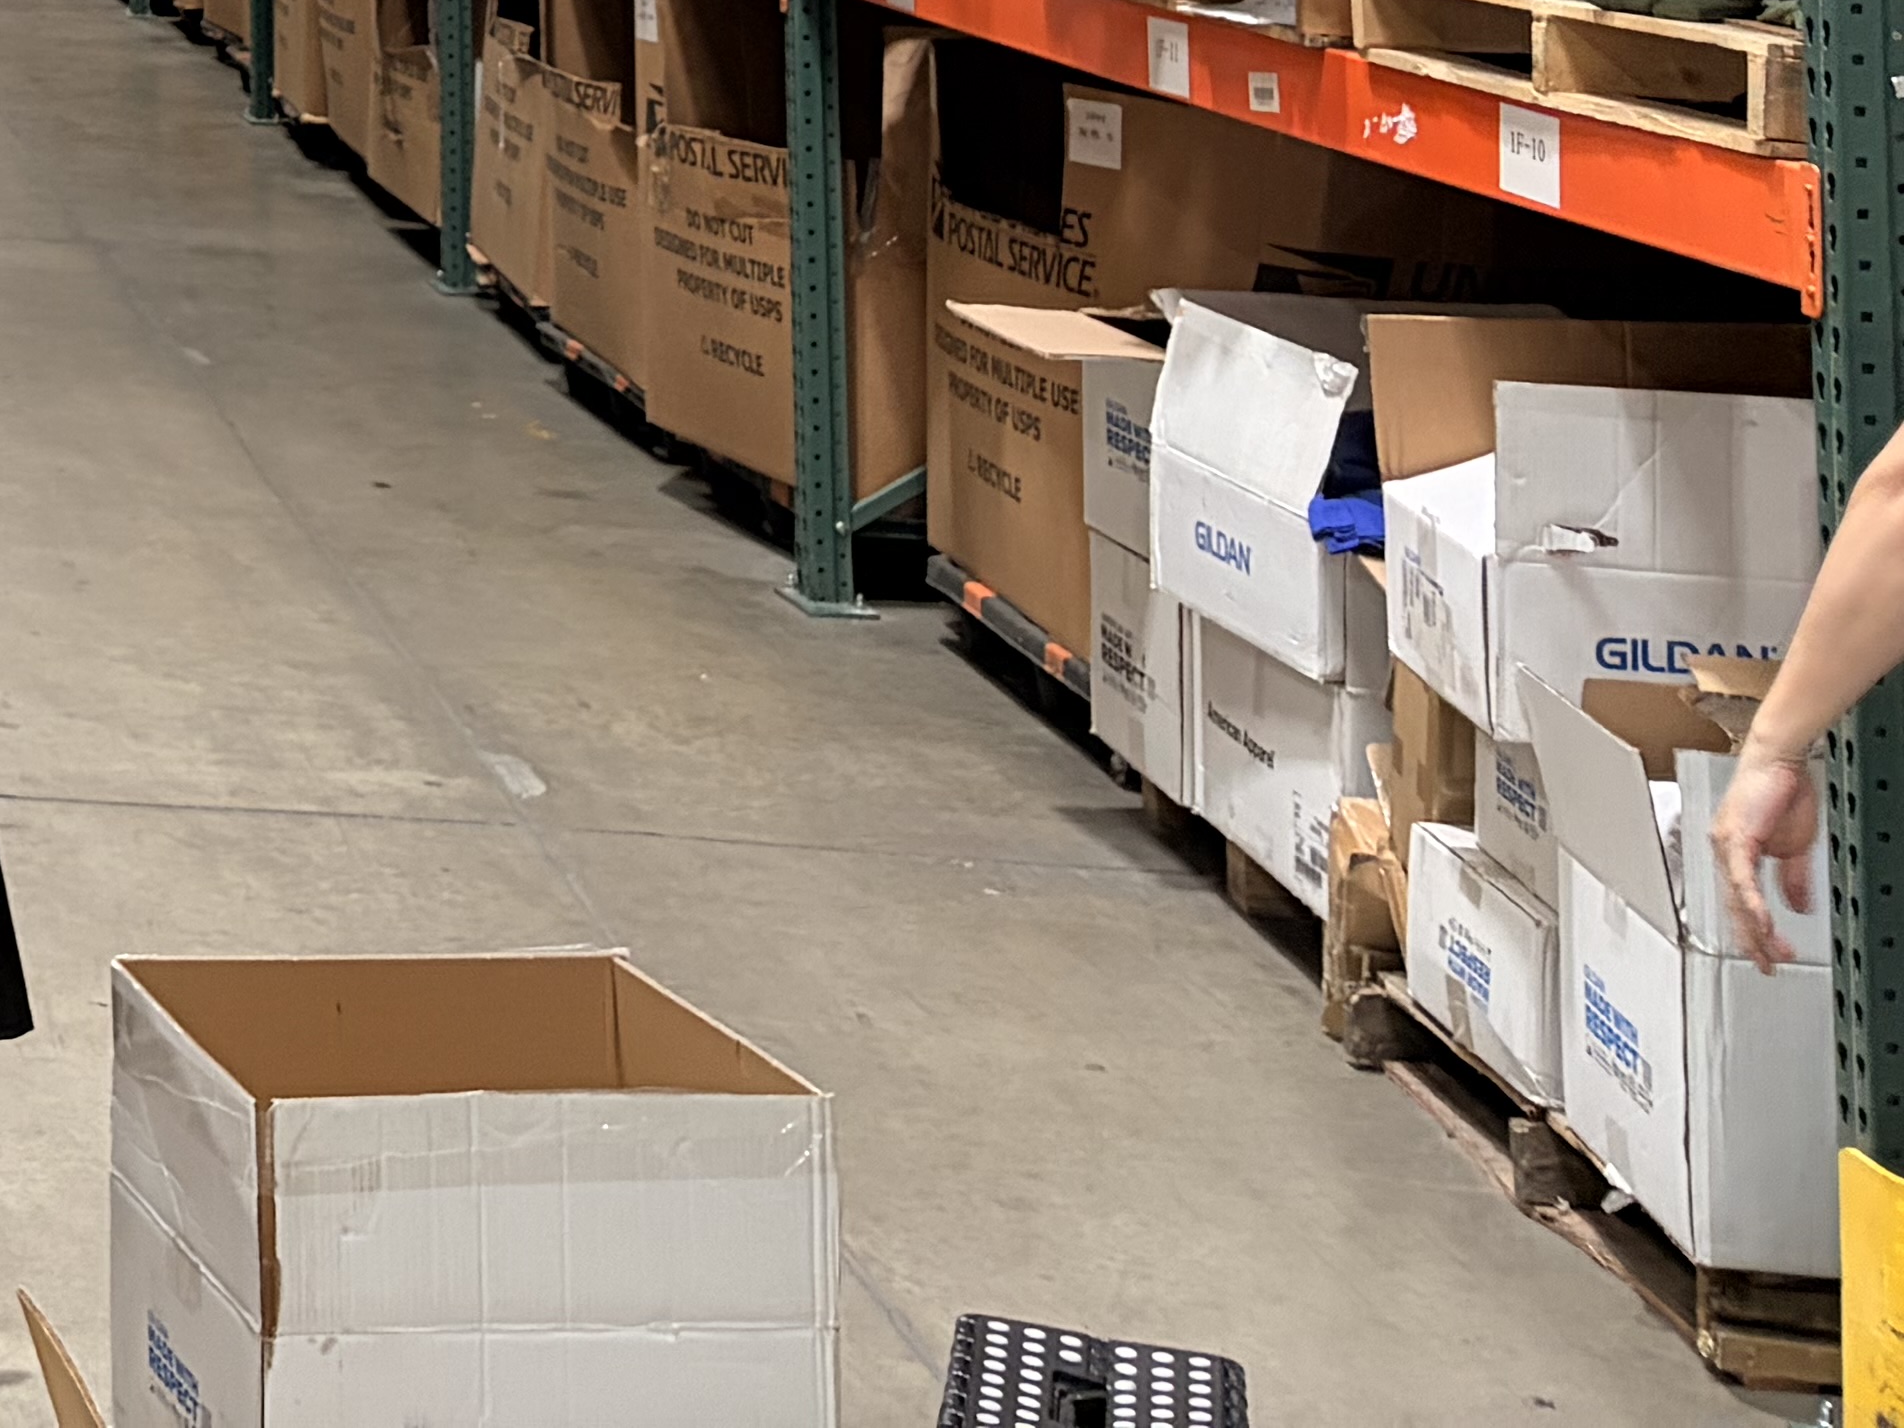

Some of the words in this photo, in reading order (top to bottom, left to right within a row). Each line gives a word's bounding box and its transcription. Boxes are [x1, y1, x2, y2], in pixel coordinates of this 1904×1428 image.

[729, 143, 788, 187] SERVI
[723, 248, 785, 289] MULTIPLE
[949, 210, 1003, 268] POSTAL
[1008, 237, 1095, 298] SERVICE
[749, 293, 783, 323] USPS
[708, 336, 765, 377] RECYCLE
[990, 346, 1048, 402] MULTIPLE
[1051, 383, 1079, 415] USE
[1012, 406, 1042, 442] USPS
[1106, 426, 1152, 466] RESPEC
[1195, 520, 1251, 577] GILDAN
[1583, 980, 1613, 1022] MADE
[1584, 1004, 1639, 1075] RESPECT
